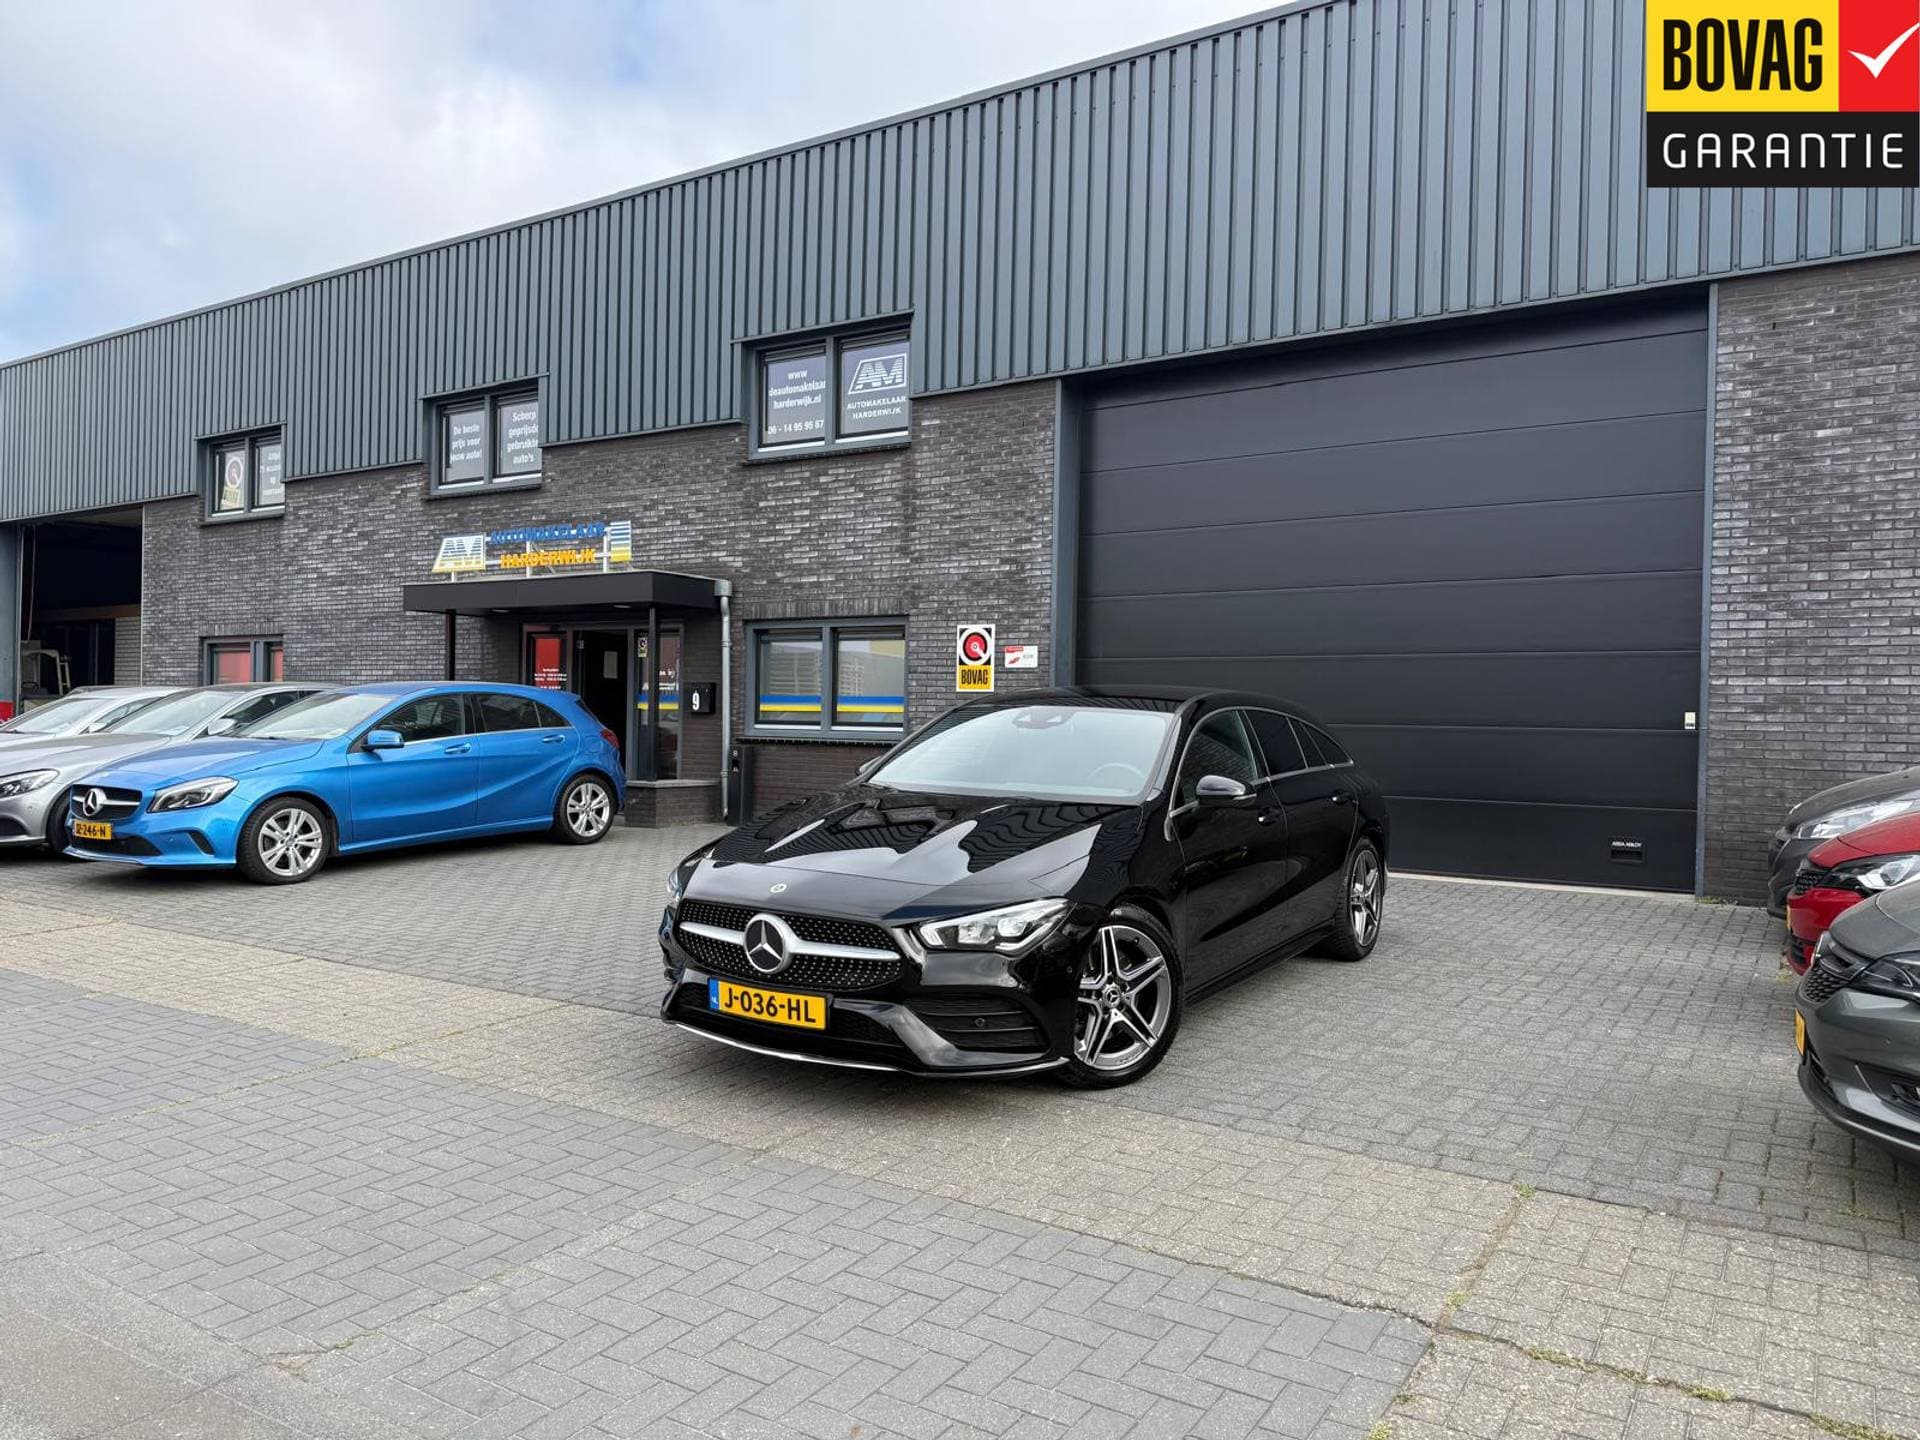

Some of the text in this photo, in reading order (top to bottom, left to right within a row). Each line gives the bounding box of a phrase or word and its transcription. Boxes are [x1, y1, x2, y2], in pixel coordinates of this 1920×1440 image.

[787, 370, 808, 380] www
[773, 394, 822, 409] harderwijk.nl
[846, 395, 907, 410] AUTOMAKELAAR
[852, 407, 902, 420] HARDERWIJK
[500, 547, 596, 569] HARDERWIJK
[961, 669, 988, 685] BOVAG
[691, 692, 700, 711] 9
[724, 987, 817, 1024] J-036-HL
